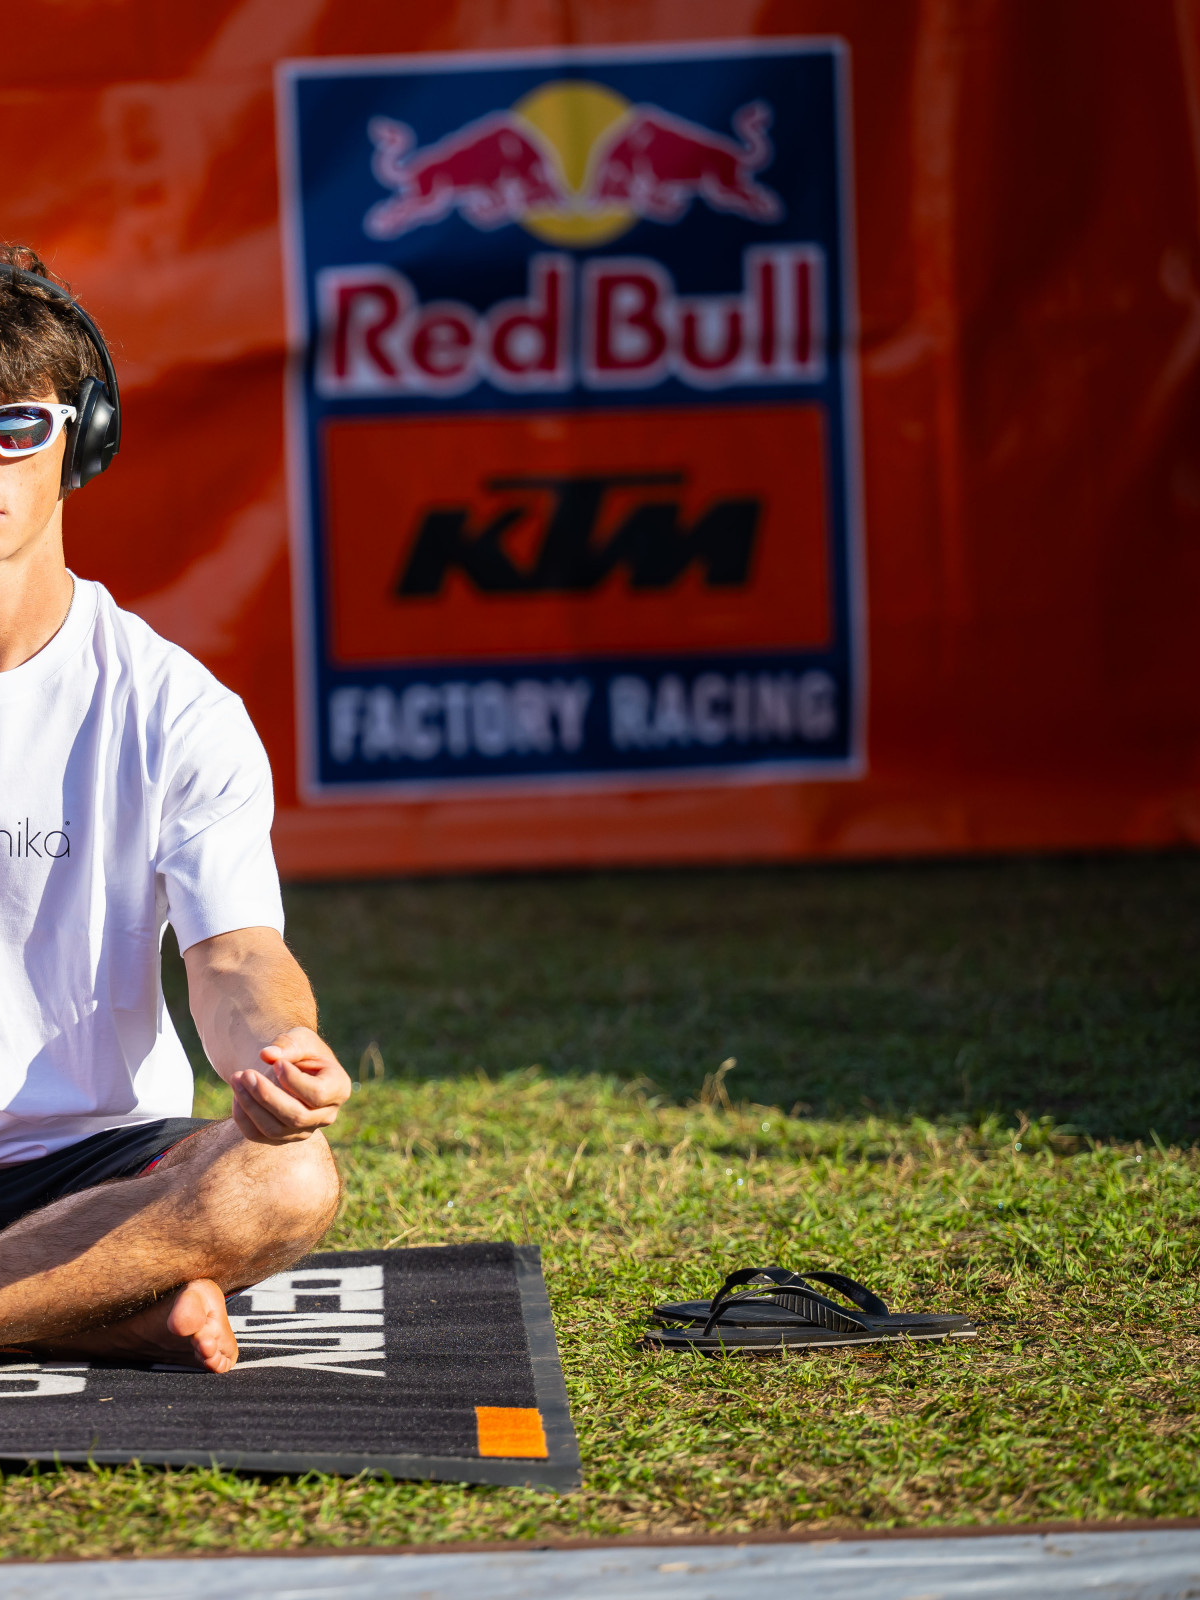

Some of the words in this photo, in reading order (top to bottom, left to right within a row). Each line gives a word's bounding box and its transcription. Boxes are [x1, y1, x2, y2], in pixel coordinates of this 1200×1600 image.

[316, 255, 573, 396] Red
[581, 245, 826, 389] Bull
[392, 471, 764, 602] KTM
[328, 679, 591, 762] FACTORY
[611, 671, 836, 750] RACING
